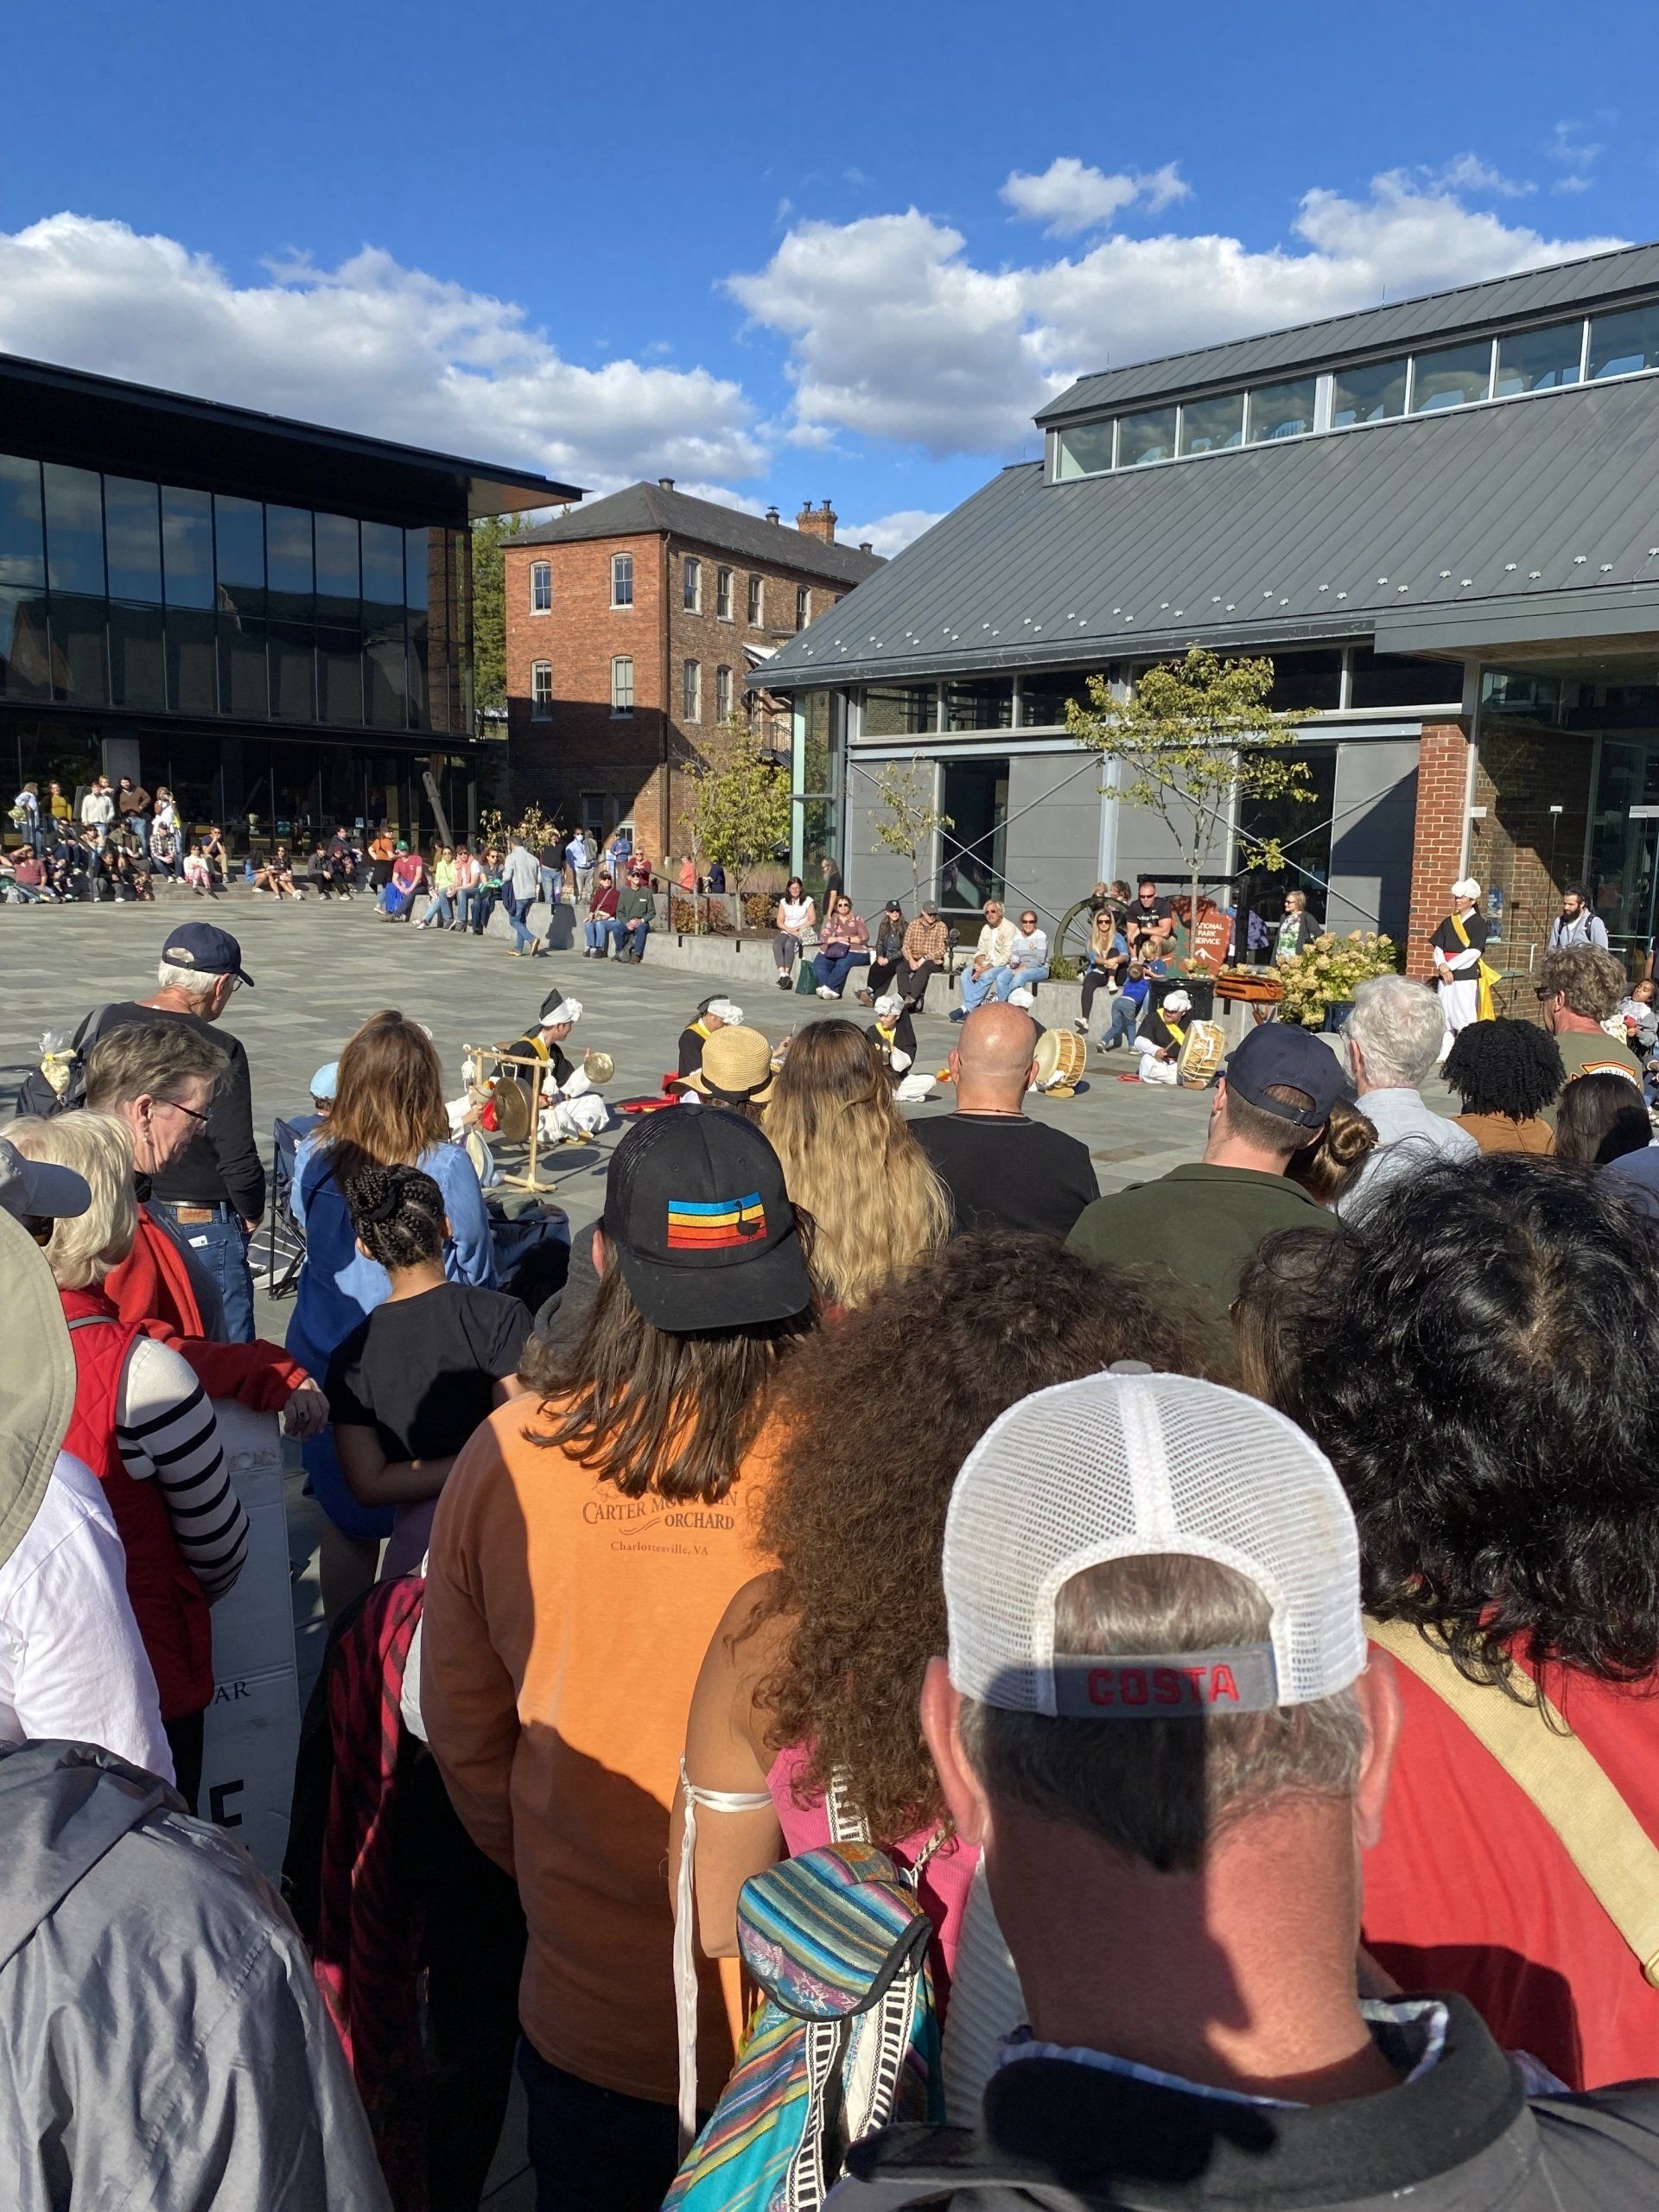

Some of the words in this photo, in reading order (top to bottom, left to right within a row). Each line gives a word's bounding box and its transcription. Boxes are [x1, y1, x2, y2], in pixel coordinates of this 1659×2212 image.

[582, 1502, 646, 1524] CARTER
[664, 1512, 734, 1529] ORCHARD
[610, 1541, 690, 1555] Charlottesville,
[694, 1546, 709, 1555] VA
[214, 1681, 251, 1705] AR
[1088, 1664, 1240, 1706] COSTA
